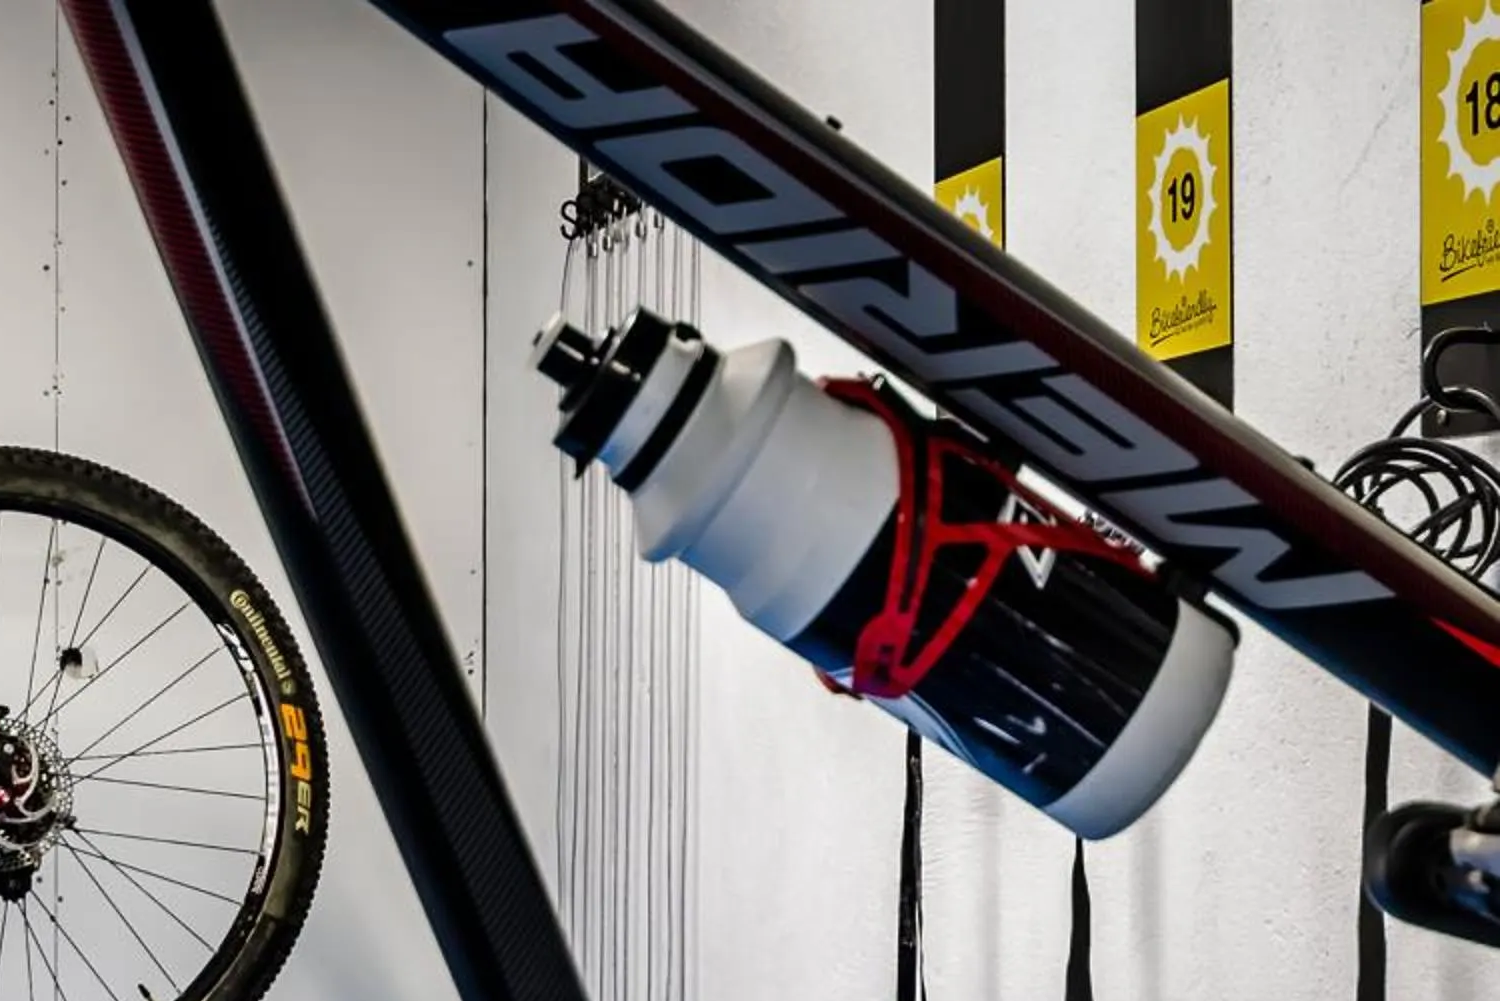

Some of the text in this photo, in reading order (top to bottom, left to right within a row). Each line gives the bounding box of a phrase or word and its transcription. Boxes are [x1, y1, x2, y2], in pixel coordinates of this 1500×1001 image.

[1465, 72, 1500, 137] 18
[1167, 172, 1196, 224] 19
[443, 13, 1397, 610] MERIDA
